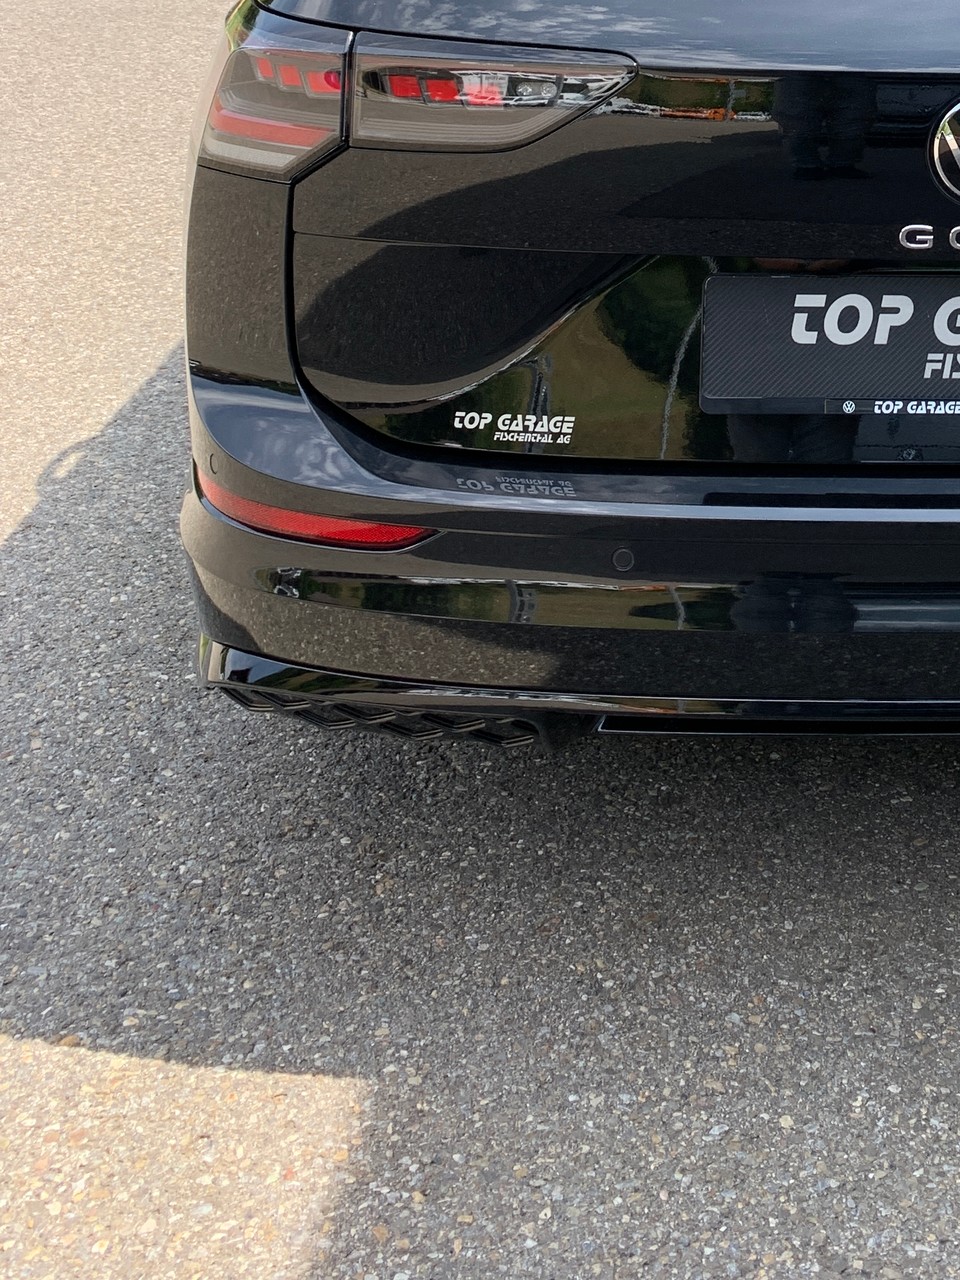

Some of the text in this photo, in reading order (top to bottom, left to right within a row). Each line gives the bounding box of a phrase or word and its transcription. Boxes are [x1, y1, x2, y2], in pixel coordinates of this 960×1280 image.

[791, 294, 914, 345] TOP
[874, 400, 903, 414] TOP
[454, 411, 576, 434] TOP GARAGE
[494, 431, 571, 444] FISCHENTHAL AG
